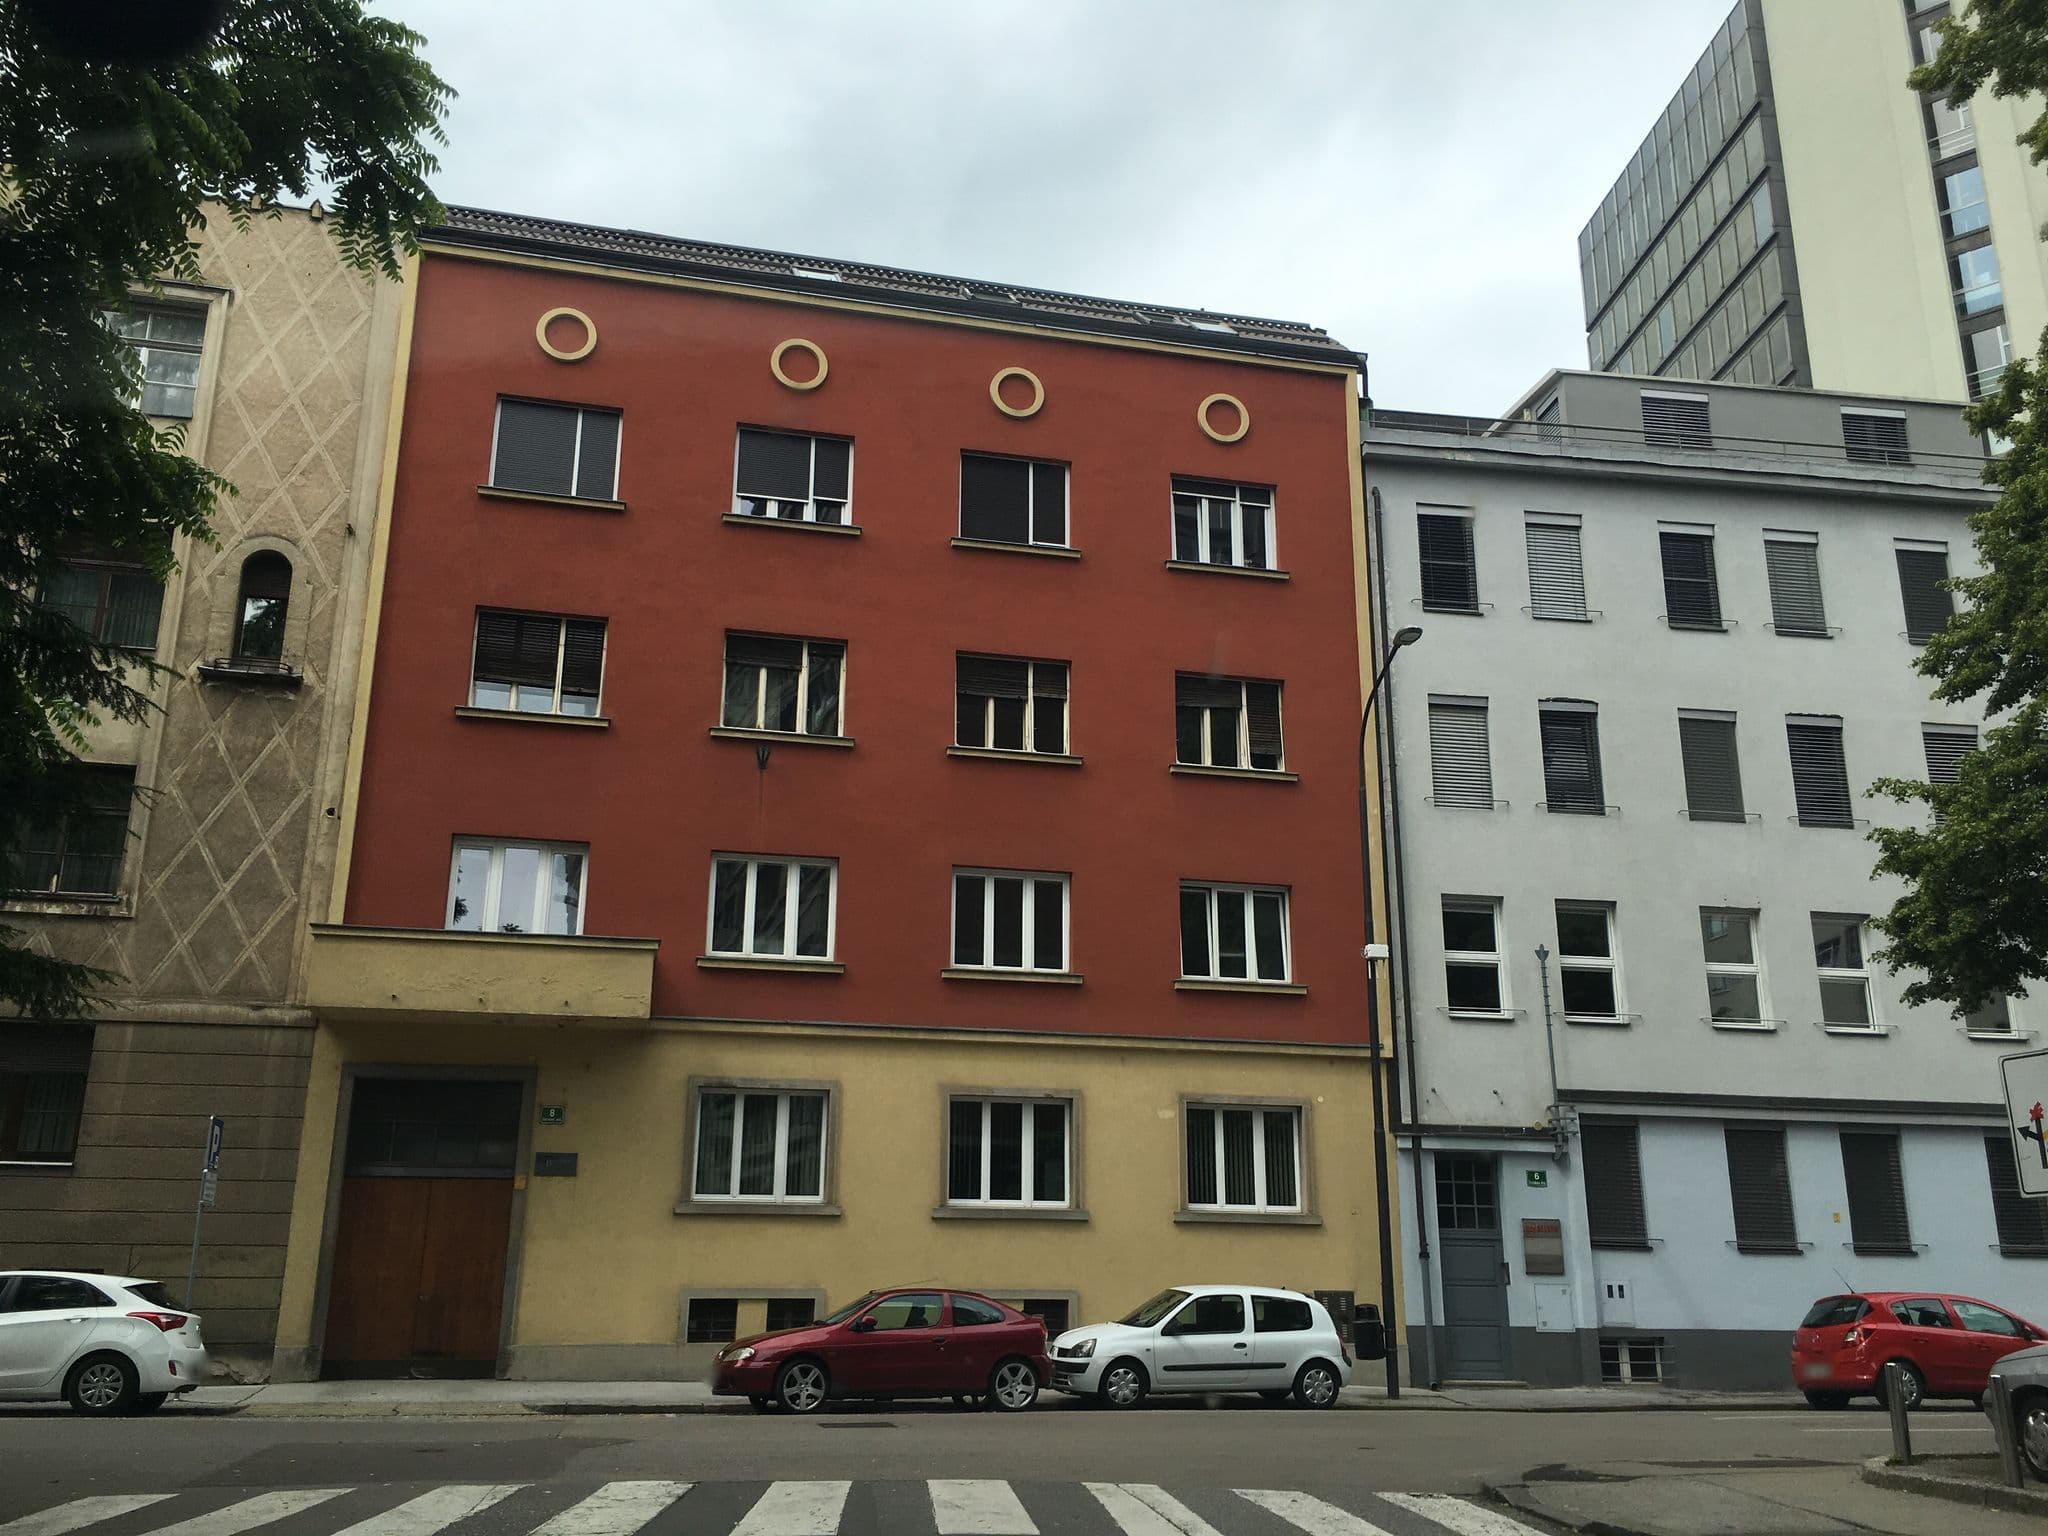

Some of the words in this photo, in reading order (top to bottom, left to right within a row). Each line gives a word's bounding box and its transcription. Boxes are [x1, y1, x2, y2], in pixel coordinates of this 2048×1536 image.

[550, 1108, 555, 1117] 8
[211, 1125, 220, 1161] P
[1534, 1172, 1540, 1180] 6
